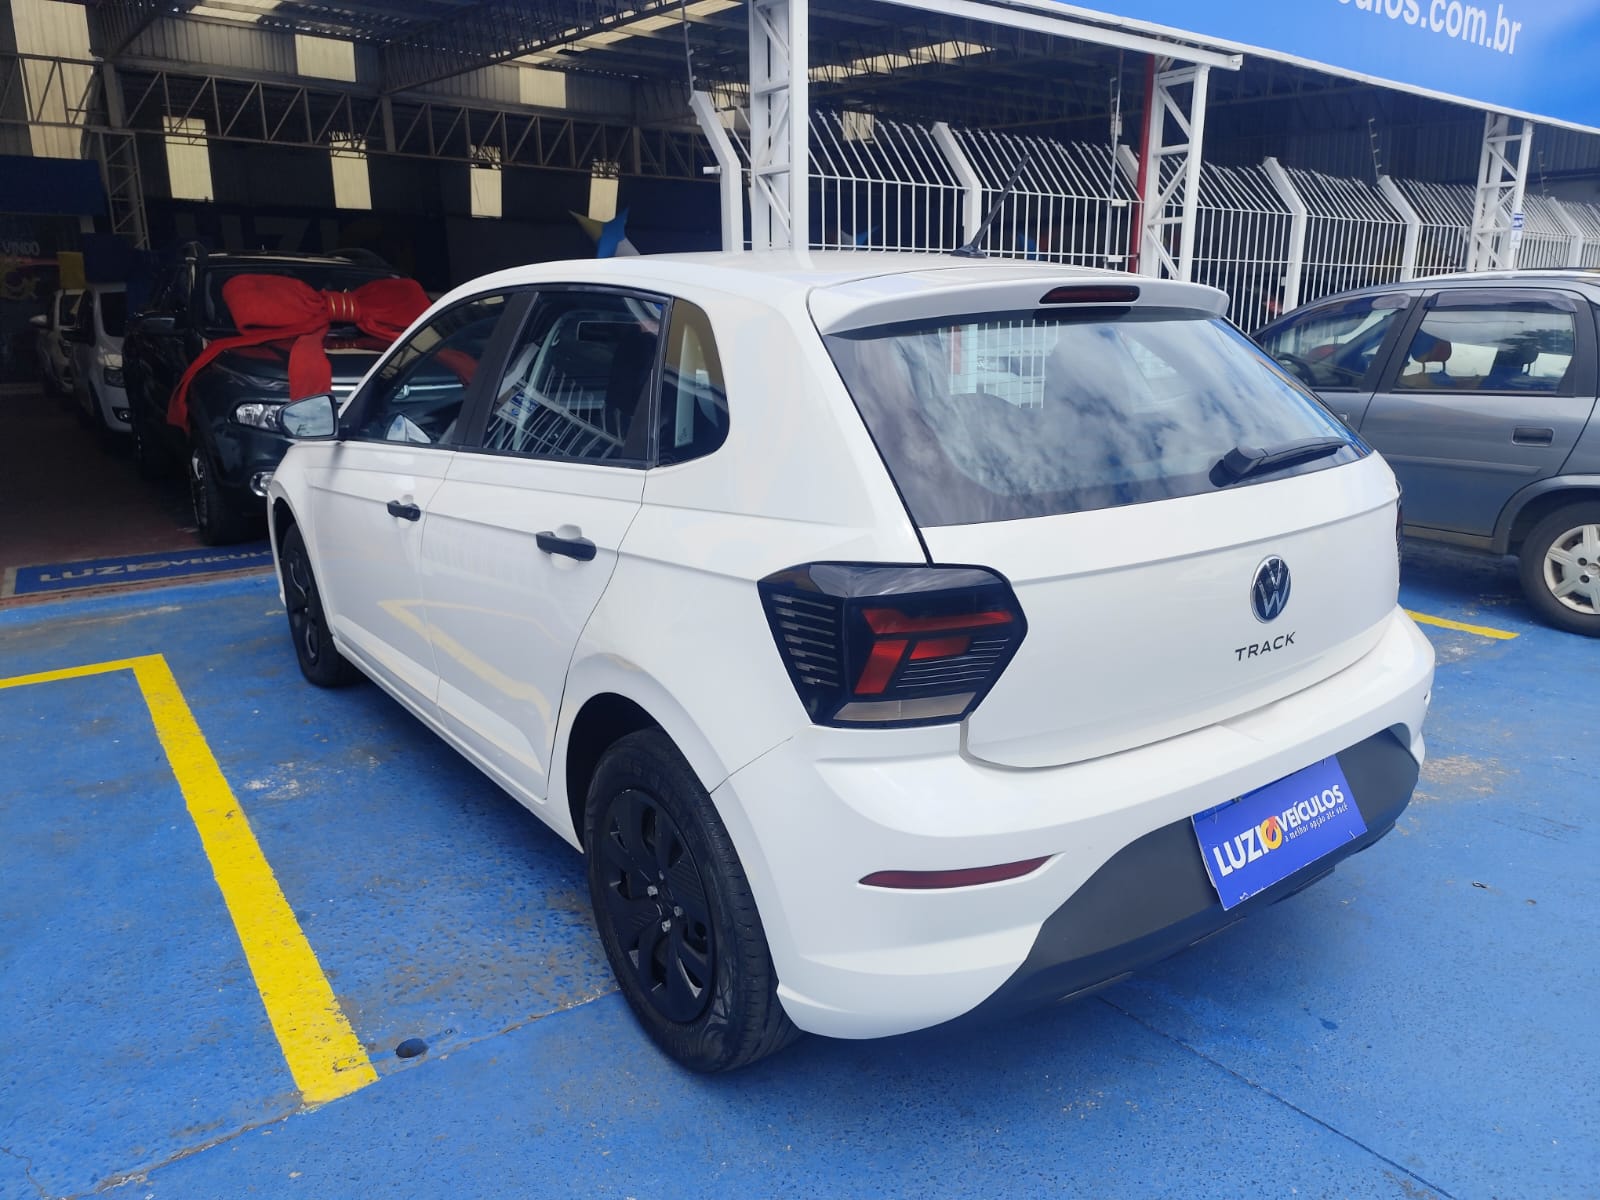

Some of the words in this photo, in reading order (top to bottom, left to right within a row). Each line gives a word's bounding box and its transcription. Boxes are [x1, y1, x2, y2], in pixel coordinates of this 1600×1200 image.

[1337, 0, 1522, 54] os.com.br
[1234, 631, 1296, 662] TRACK
[1212, 815, 1283, 877] LUZIO
[1275, 784, 1345, 833] VEÍCULOS
